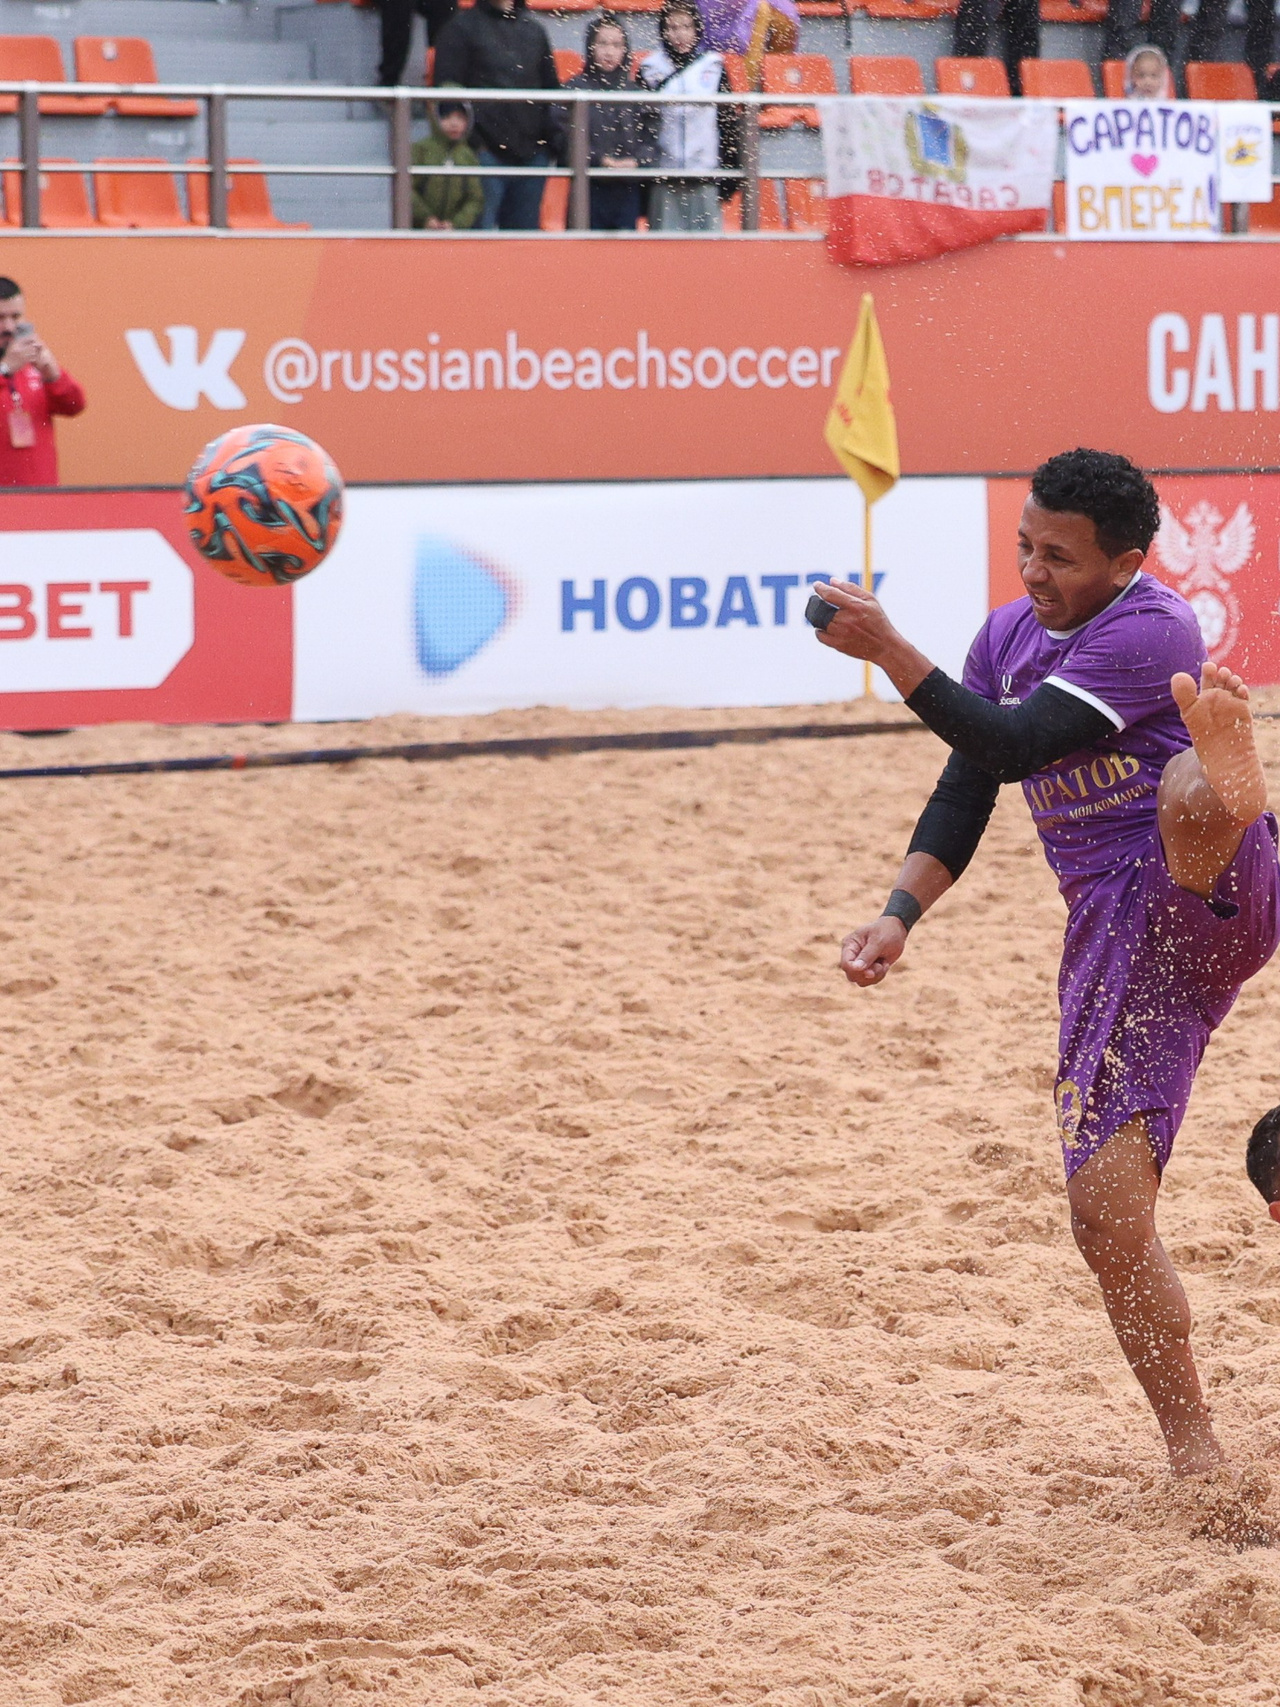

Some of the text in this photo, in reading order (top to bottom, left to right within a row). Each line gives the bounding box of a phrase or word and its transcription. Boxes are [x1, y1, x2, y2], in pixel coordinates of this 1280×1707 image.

[1069, 108, 1214, 156] САРАТОВ
[264, 329, 841, 404] @russianbeachsoccer
[561, 572, 886, 632] НОВАТ
[1031, 752, 1141, 812] АРАТОВ
